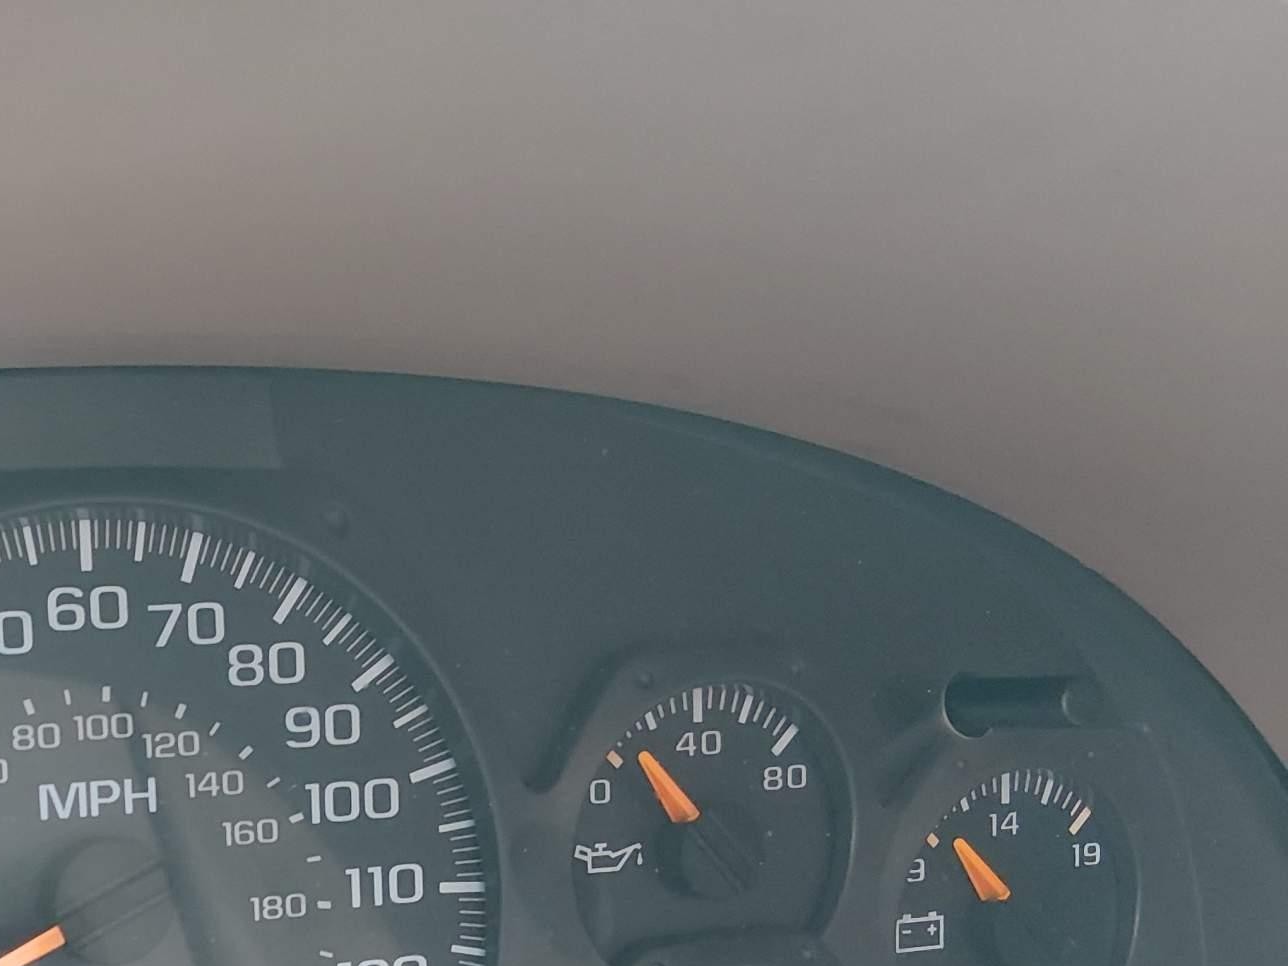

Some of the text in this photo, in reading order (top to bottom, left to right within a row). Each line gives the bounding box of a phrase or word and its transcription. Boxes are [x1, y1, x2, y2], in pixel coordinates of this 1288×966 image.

[48, 586, 128, 630] 60
[148, 602, 224, 647] 70
[229, 642, 305, 686] 80
[13, 723, 60, 750] 80
[73, 714, 133, 740] 100
[286, 704, 360, 747] 90
[143, 731, 199, 758] 120
[676, 731, 721, 756] 40
[186, 771, 243, 797] 140
[764, 765, 806, 790] 80
[39, 778, 156, 820] MPH
[305, 778, 399, 824] 100
[590, 780, 610, 803] 0
[222, 819, 278, 846] 160
[990, 812, 1019, 836] 14
[1073, 843, 1100, 866] 19
[345, 864, 423, 908] 110
[250, 894, 306, 921] 180
